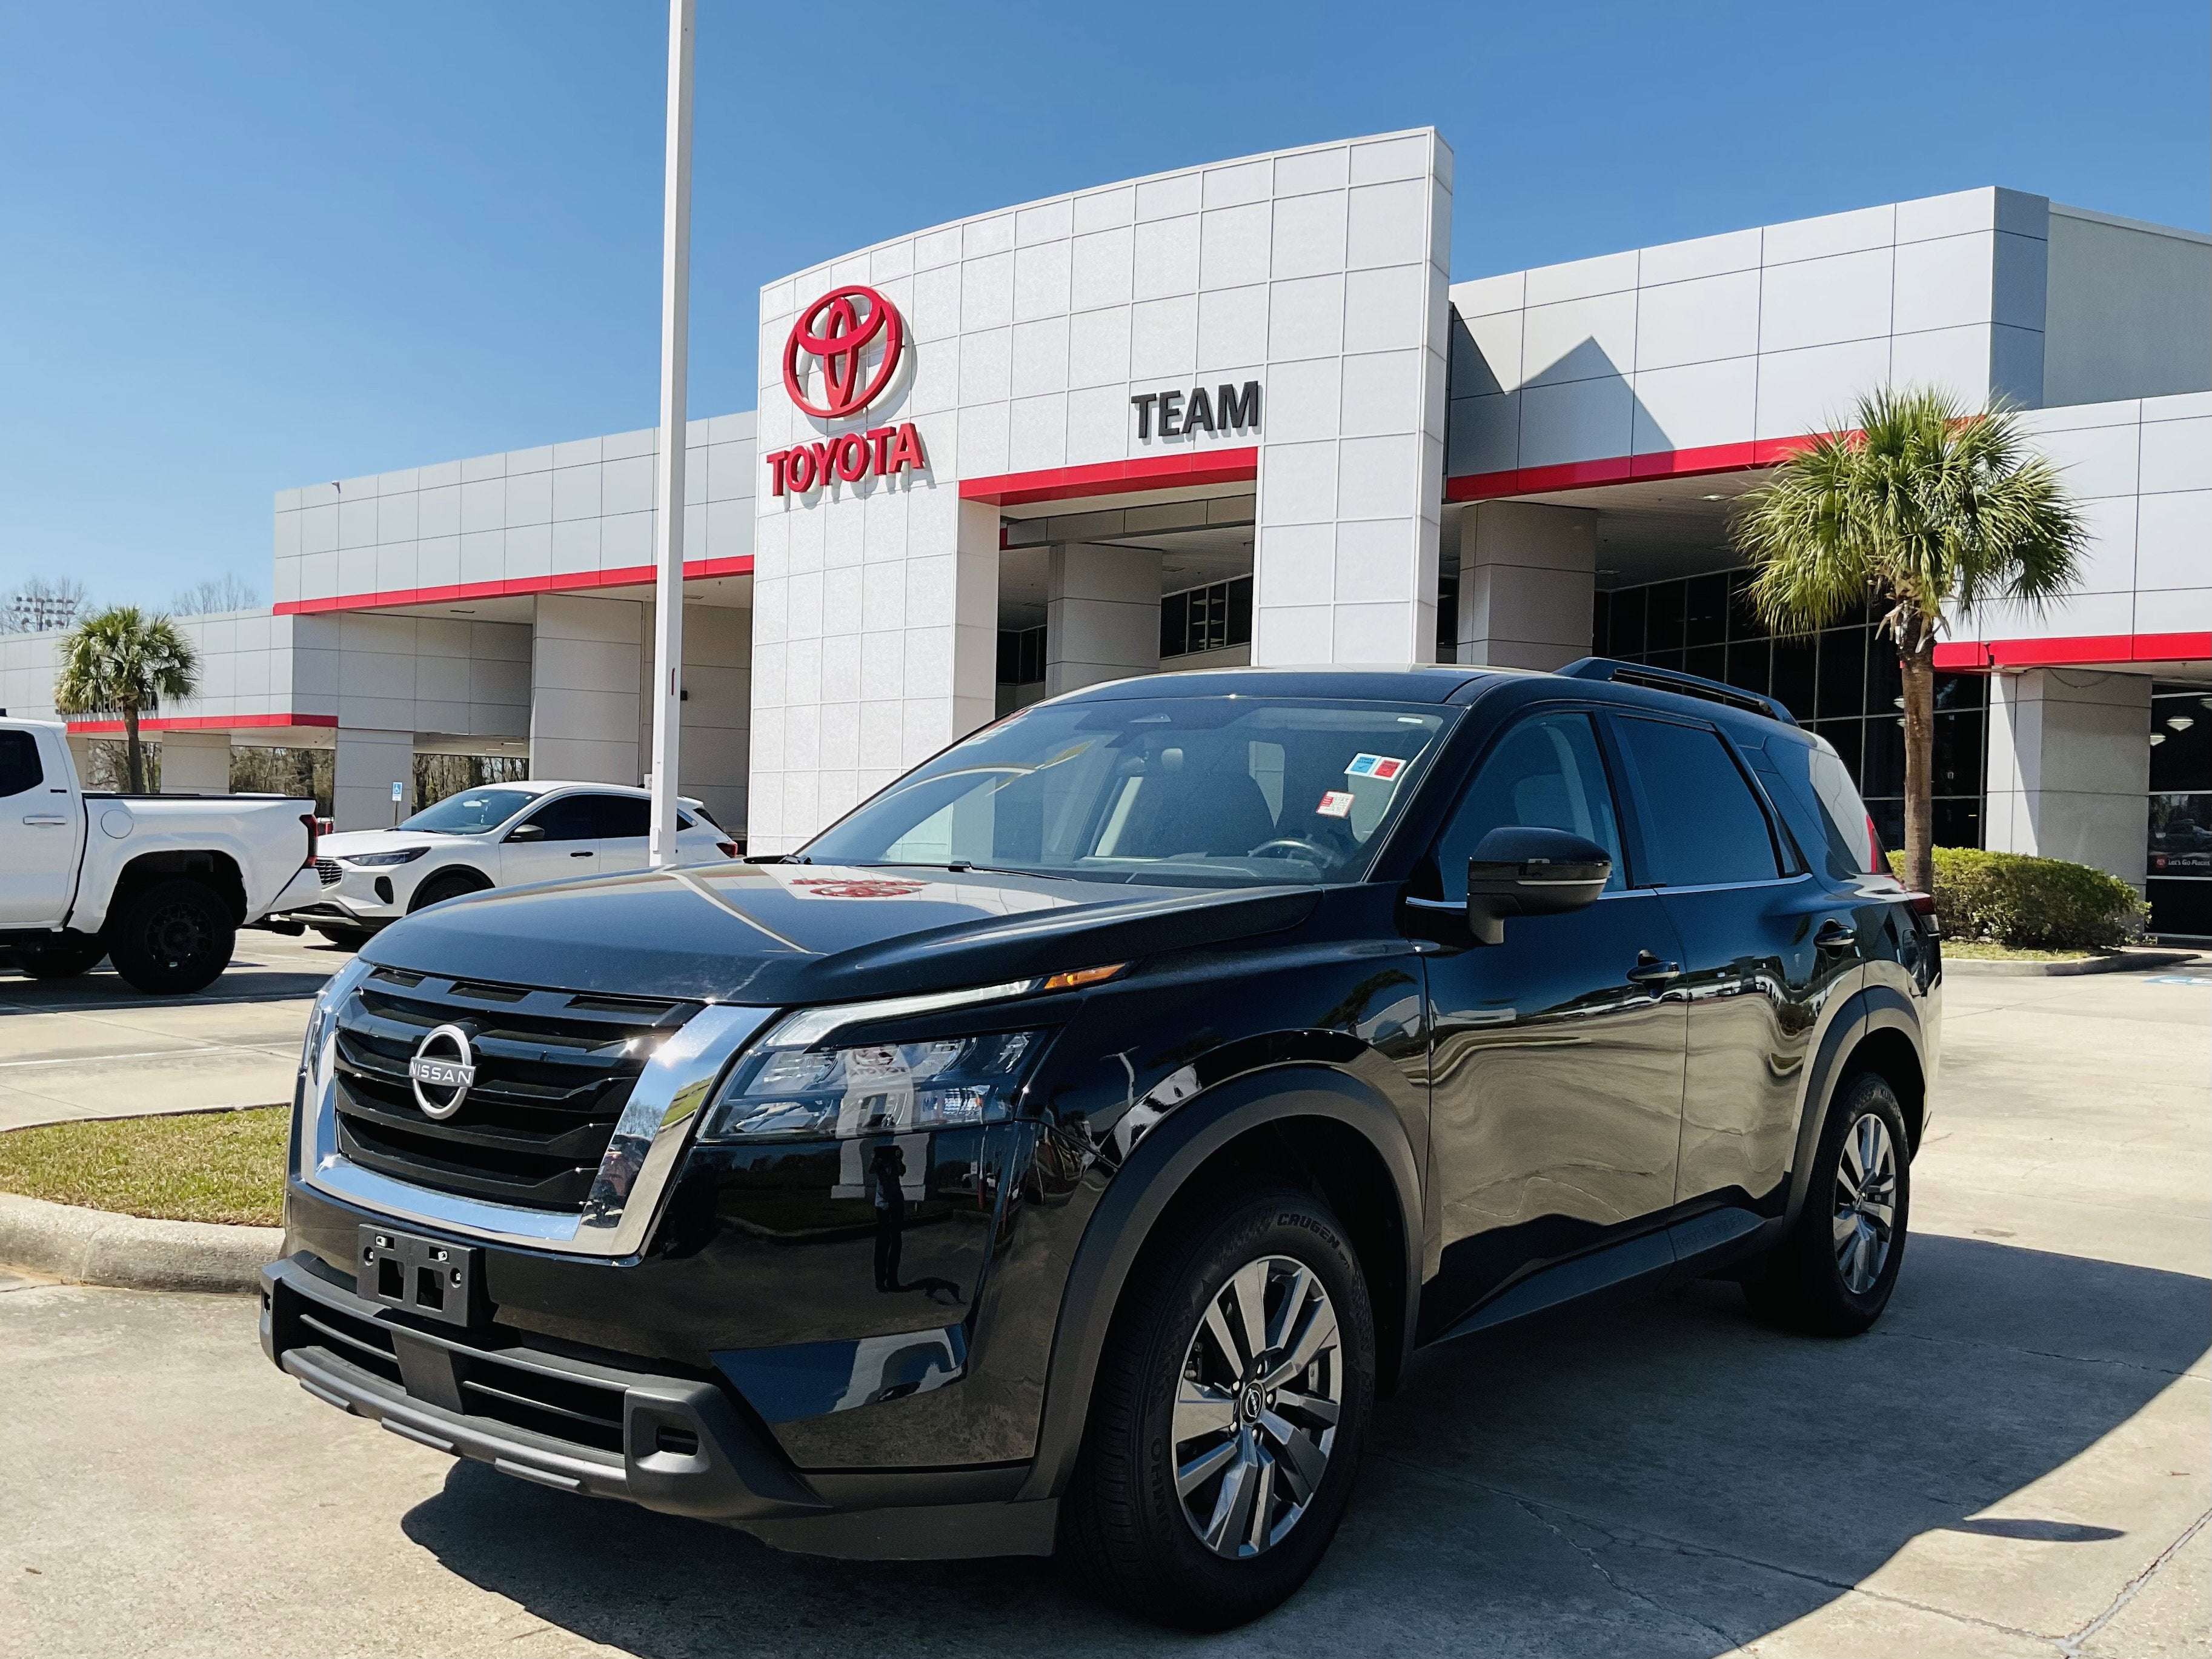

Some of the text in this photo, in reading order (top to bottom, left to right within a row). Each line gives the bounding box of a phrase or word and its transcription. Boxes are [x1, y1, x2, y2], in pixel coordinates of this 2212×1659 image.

[1131, 381, 1258, 438] TEAM
[766, 422, 925, 496] TOYOTA
[410, 1061, 471, 1084] NISSAN
[1277, 1213, 1340, 1249] CRUGEN
